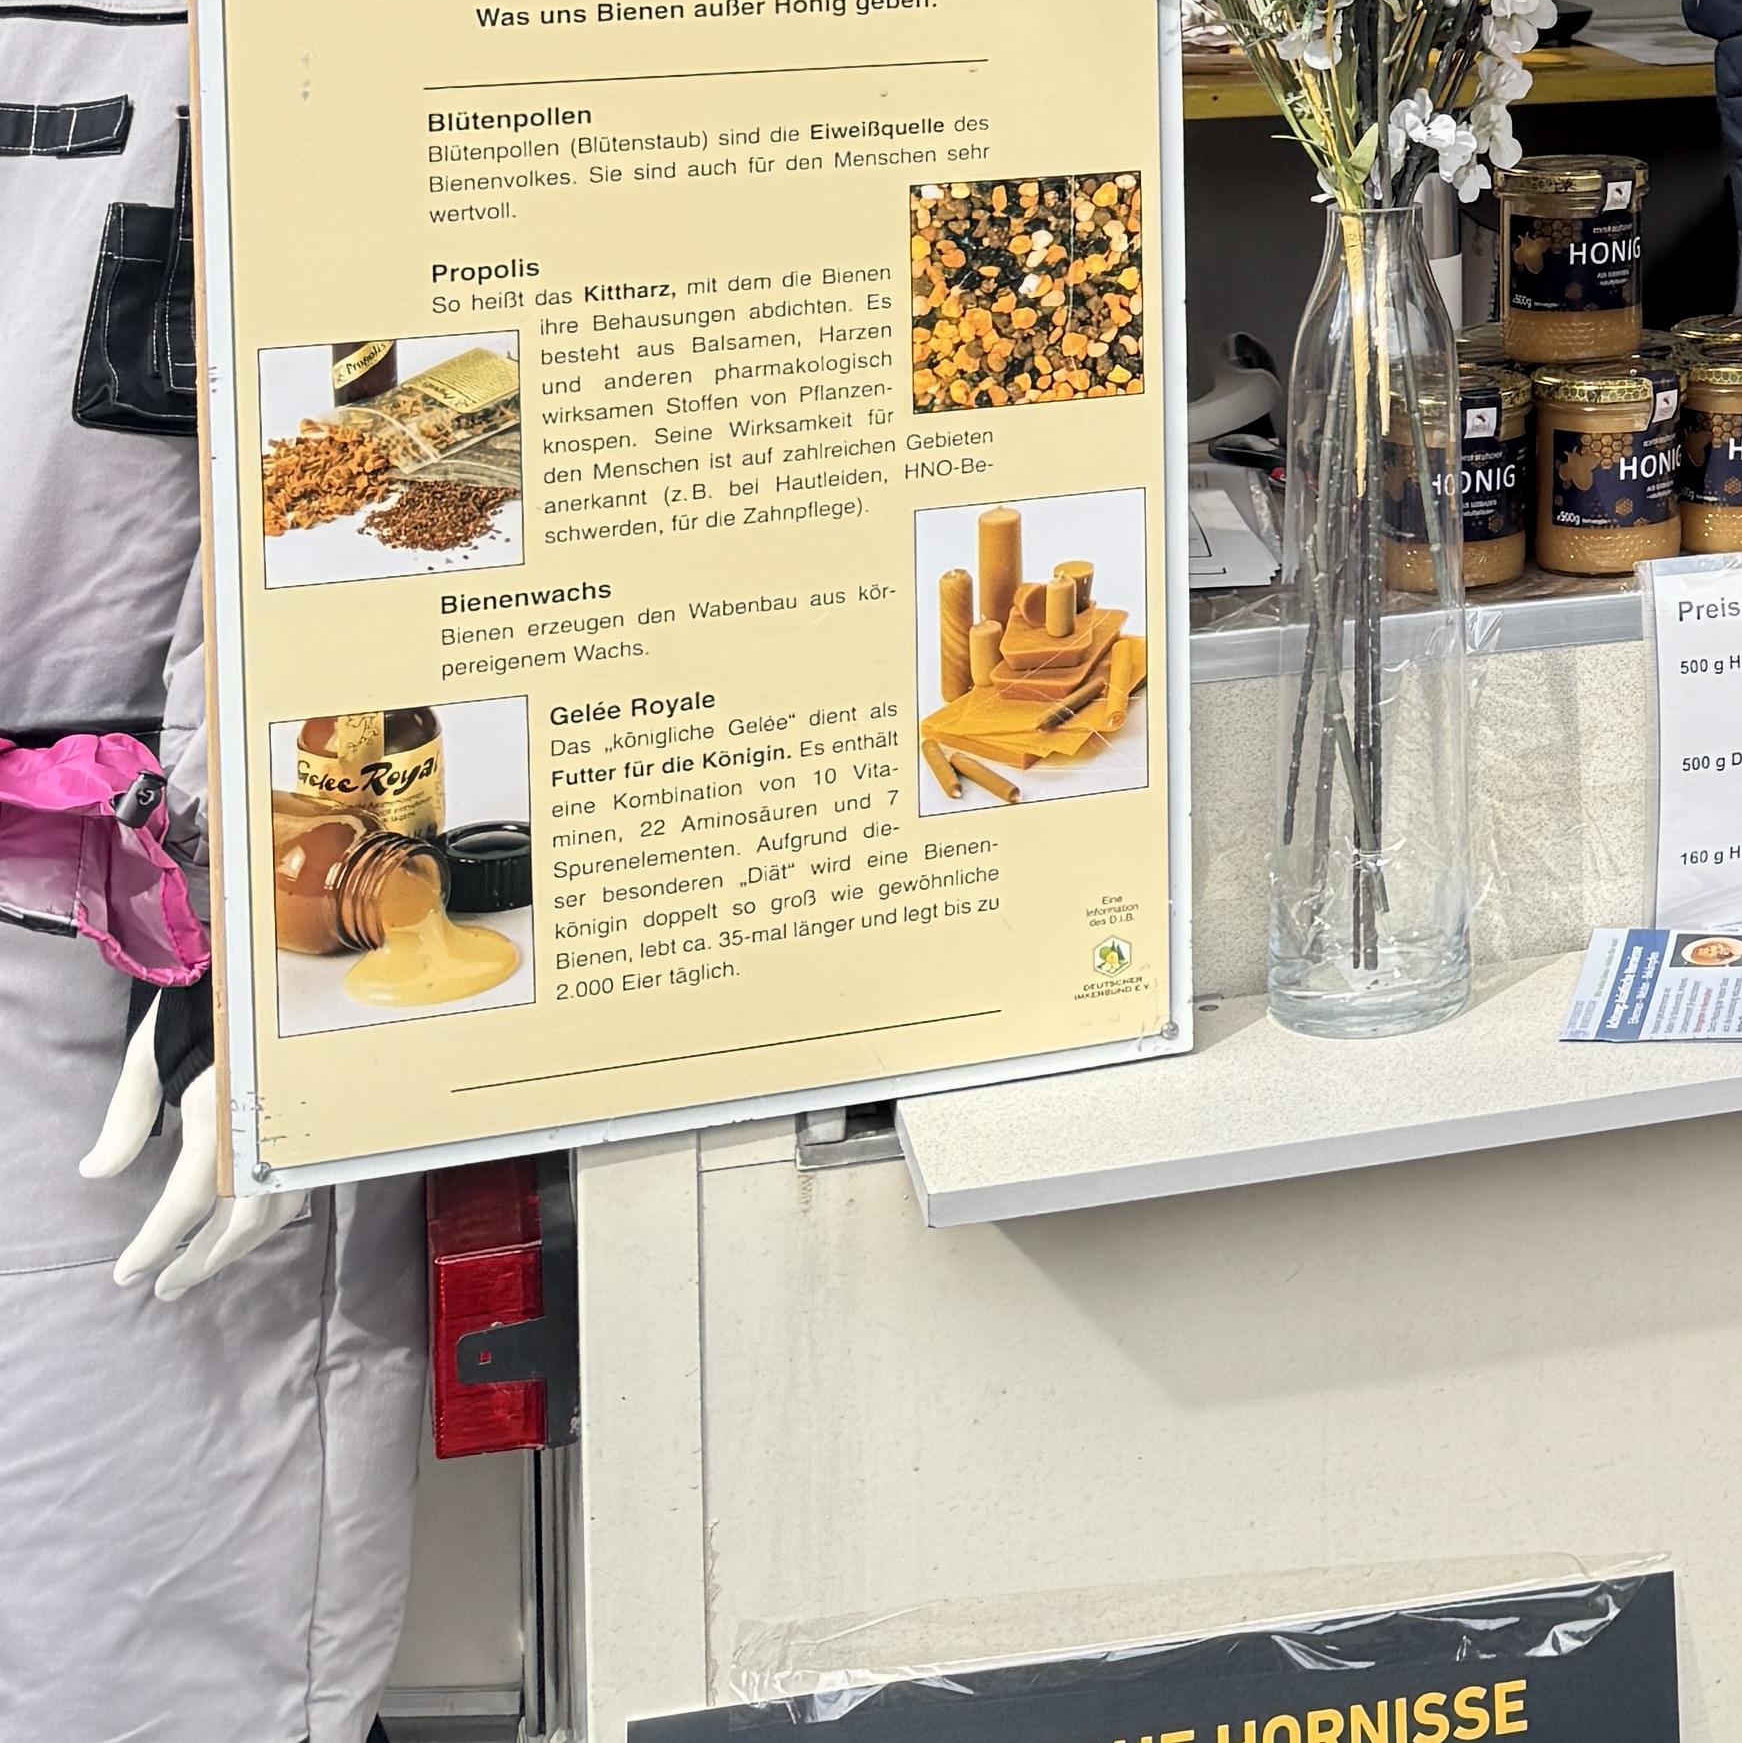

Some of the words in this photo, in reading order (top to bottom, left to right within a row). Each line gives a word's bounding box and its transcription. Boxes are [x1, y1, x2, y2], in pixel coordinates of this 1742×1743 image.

[475, 7, 530, 28] Was
[540, 8, 587, 25] uns
[597, 1, 685, 23] Bienen
[428, 106, 592, 134] Blütenpollen
[428, 139, 560, 164] Blütenpollen
[570, 129, 708, 159] (Blütenstaub)
[718, 126, 761, 147] sind
[769, 125, 800, 143] die
[810, 117, 945, 141] Eiweißquelle
[953, 115, 990, 133] des
[429, 169, 578, 194] Bienenvolkes.
[589, 165, 623, 184] Sie
[633, 161, 676, 181] sind
[687, 157, 737, 178] auch
[748, 156, 776, 174] für
[785, 154, 823, 171] den
[834, 148, 937, 169] Menschen
[947, 143, 991, 162] sehr
[428, 201, 517, 224] wertvoll.
[1568, 235, 1642, 266] HONIG
[432, 258, 540, 286] Propolis
[431, 295, 461, 314] So
[471, 290, 525, 312] heißt
[534, 288, 573, 307] das
[584, 282, 677, 304] Kittharz,
[687, 277, 718, 296] mit
[727, 274, 772, 292] dem
[781, 270, 812, 288] die
[822, 267, 892, 285] Bienen
[540, 317, 579, 336] ihre
[592, 308, 736, 332] Behausungen
[748, 298, 853, 320] abdichten.
[867, 293, 892, 311] Es
[440, 581, 612, 615] Bienenwachs
[441, 626, 514, 646] Bienen
[527, 614, 625, 637] erzeugen
[637, 607, 676, 626] den
[688, 595, 797, 620] Wabenbau
[809, 591, 846, 607] aus
[858, 583, 897, 602] kör-
[441, 651, 566, 682] pereigenem
[573, 640, 650, 663] Wachs.
[1680, 658, 1709, 675] 500
[1713, 659, 1724, 675] g
[549, 700, 622, 726] Gelée
[631, 690, 716, 719] Royale
[550, 739, 592, 758] Das
[808, 706, 858, 727] dient
[869, 701, 898, 720] als
[551, 767, 617, 788] Futter
[623, 760, 655, 779] für
[661, 755, 695, 775] die
[702, 744, 793, 770] Königin.
[800, 739, 826, 758] Es
[831, 730, 899, 754] enthält
[1681, 755, 1711, 772] 500
[1715, 756, 1726, 772] g
[1679, 849, 1709, 866] 160
[1713, 850, 1724, 865] g
[1101, 895, 1123, 905] Eine
[556, 977, 614, 1001] 2.000
[622, 972, 663, 992] Eier
[669, 960, 741, 987] täglich.
